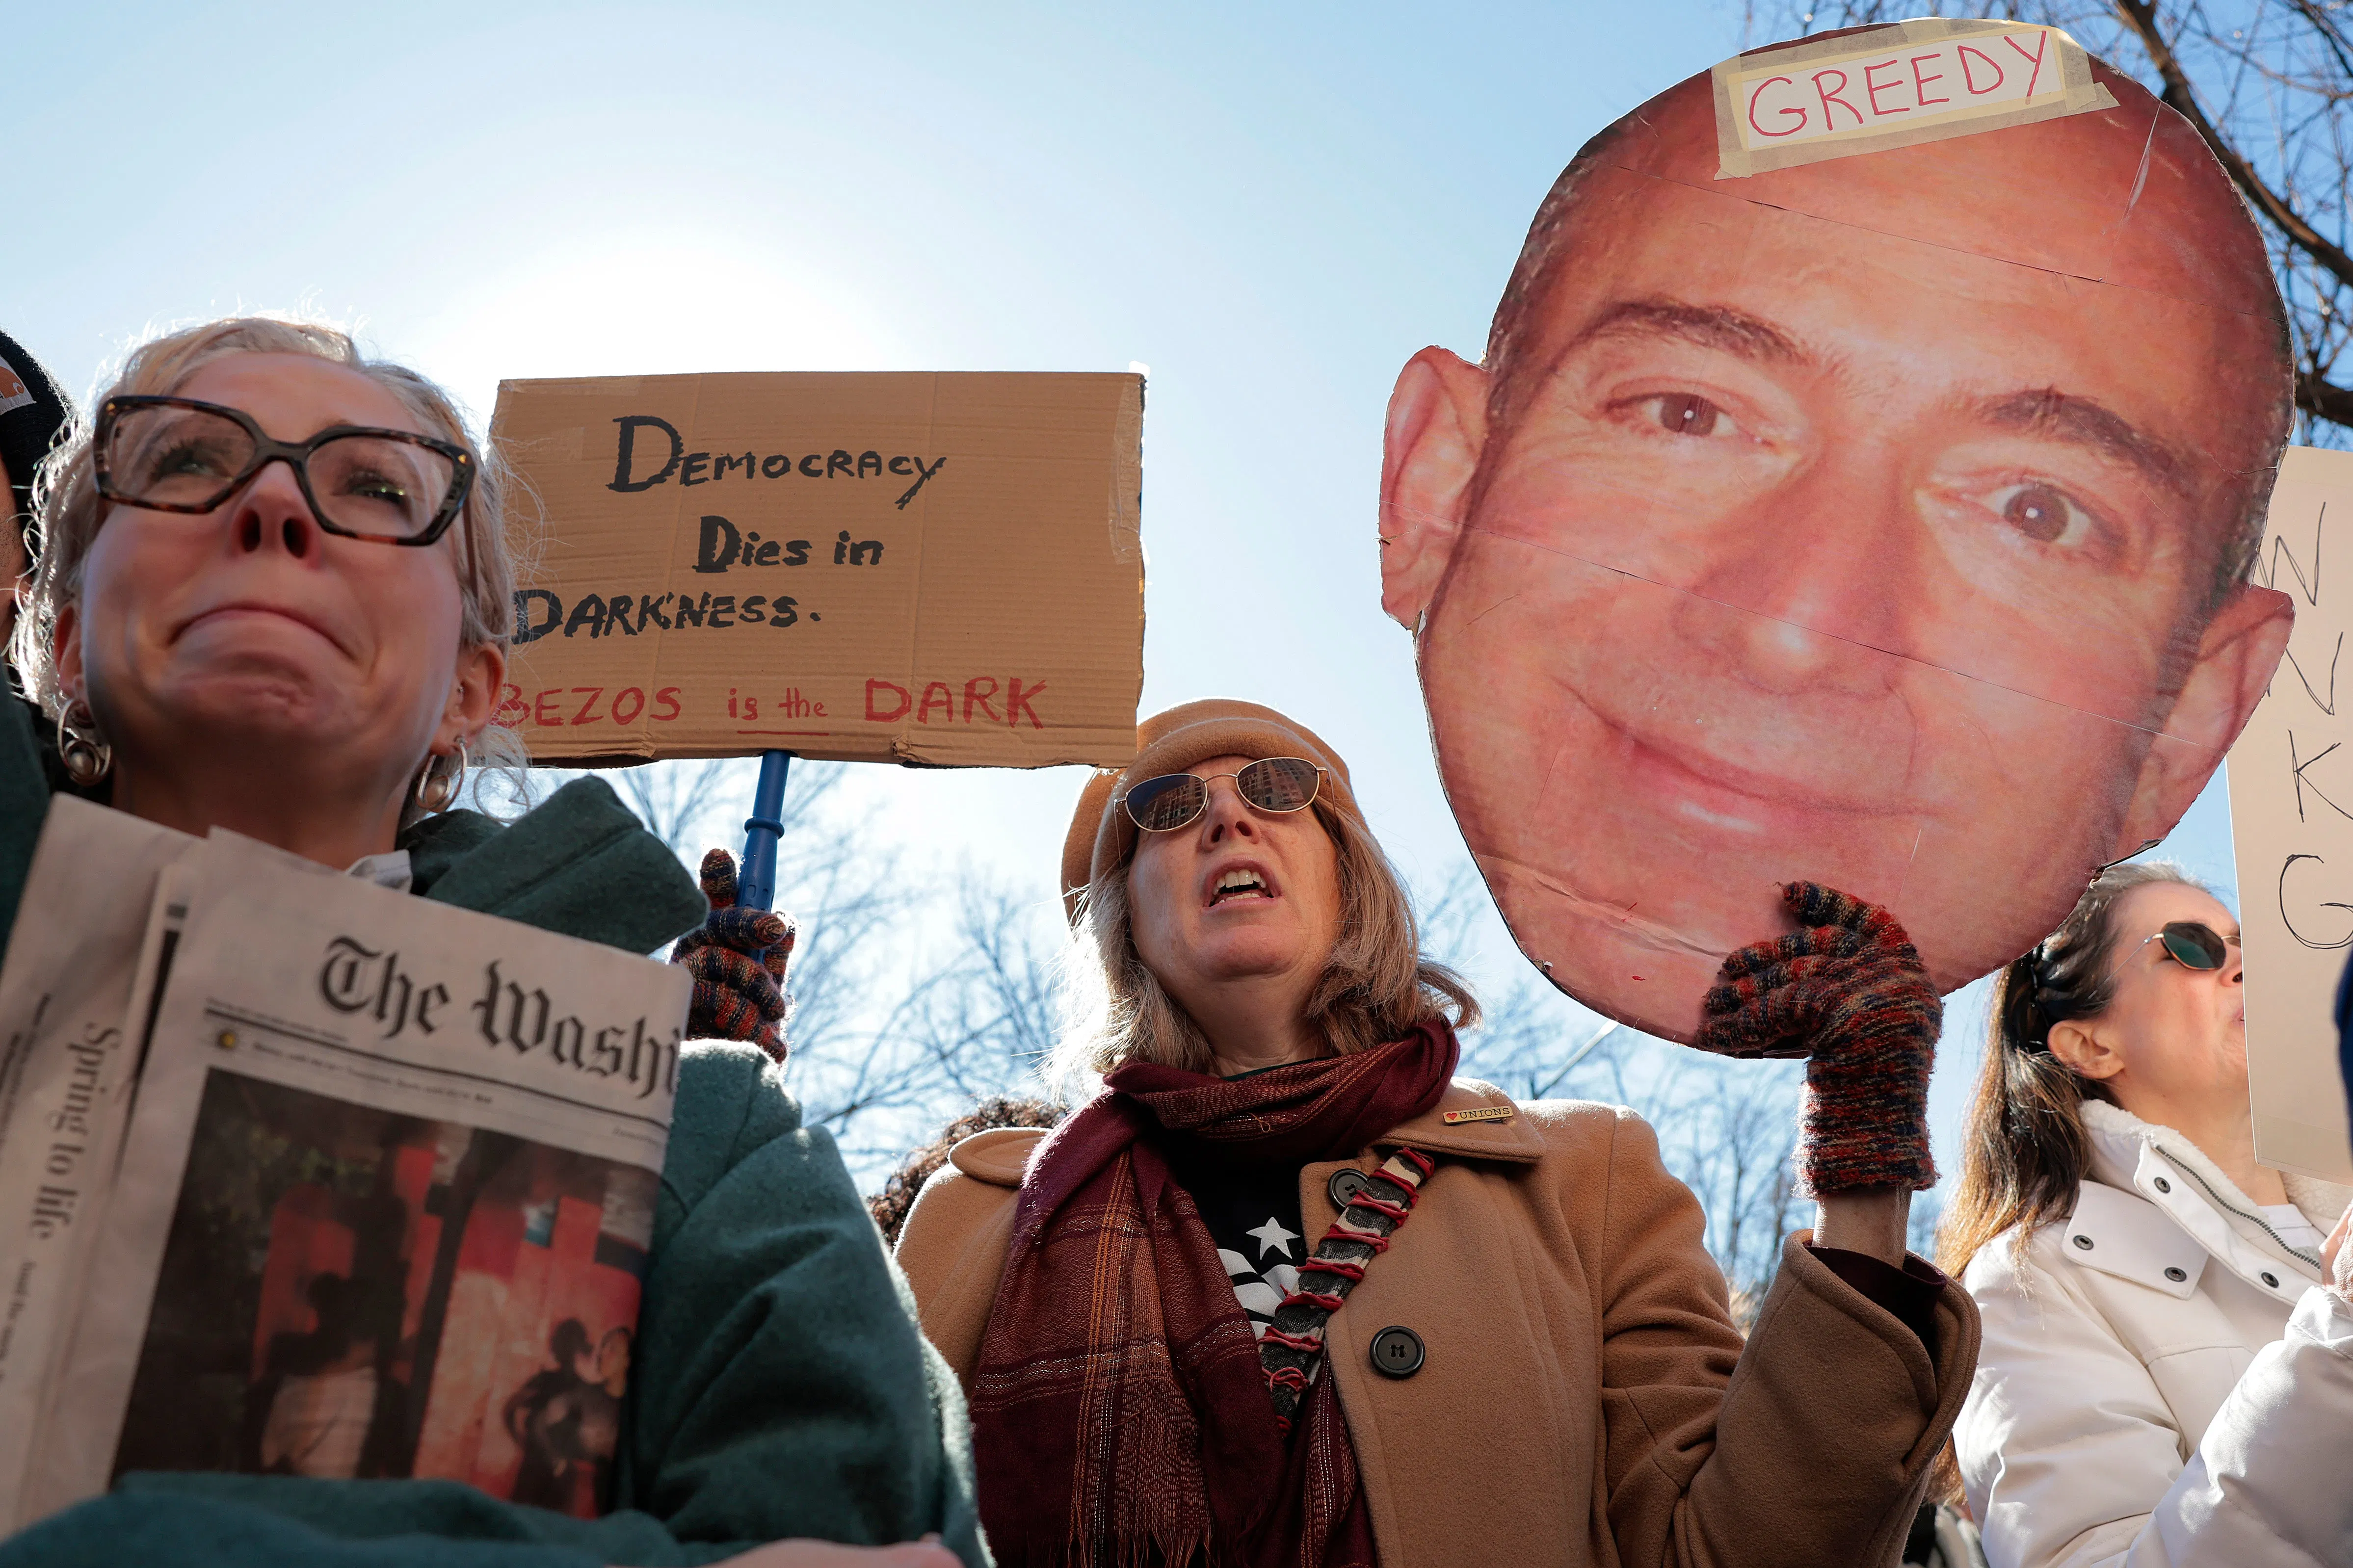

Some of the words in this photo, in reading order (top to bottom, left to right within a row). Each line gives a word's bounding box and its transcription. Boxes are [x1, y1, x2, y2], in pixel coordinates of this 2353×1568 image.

[1748, 29, 2047, 137] GREEDY
[606, 415, 947, 510] DEMOCRACY
[692, 515, 813, 573] Dies
[834, 529, 884, 567] in
[491, 683, 681, 728] BEZOS
[728, 688, 758, 721] is
[778, 688, 828, 719] the
[865, 676, 1047, 729] DARK
[318, 935, 451, 1041] The
[48, 1020, 121, 1136] Spring
[1458, 1107, 1510, 1120] UNIONS
[30, 1183, 79, 1240] life
